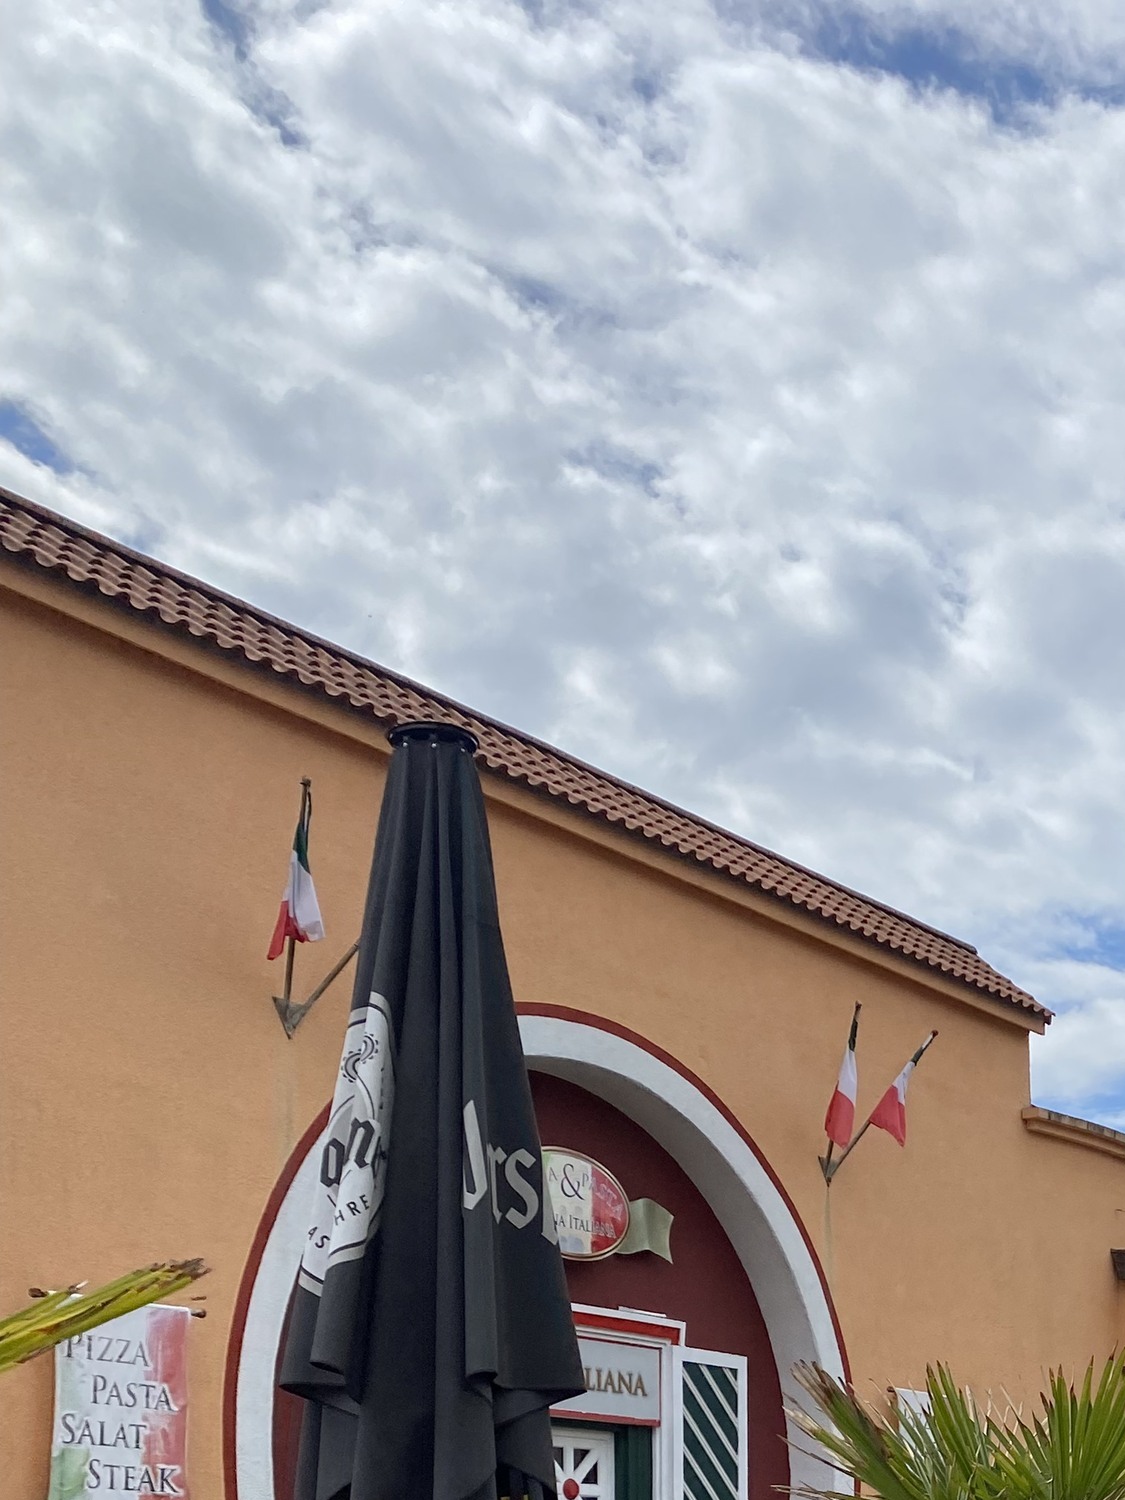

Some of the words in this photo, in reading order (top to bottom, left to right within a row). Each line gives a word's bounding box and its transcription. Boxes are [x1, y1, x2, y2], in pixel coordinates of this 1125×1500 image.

[560, 1163, 586, 1200] &
[582, 1172, 624, 1222] PASTA
[63, 1332, 151, 1368] PIZZA
[91, 1374, 177, 1412] PASTA
[584, 1367, 648, 1397] LIANA
[60, 1412, 147, 1450] SALAT
[86, 1458, 181, 1494] STEAK
